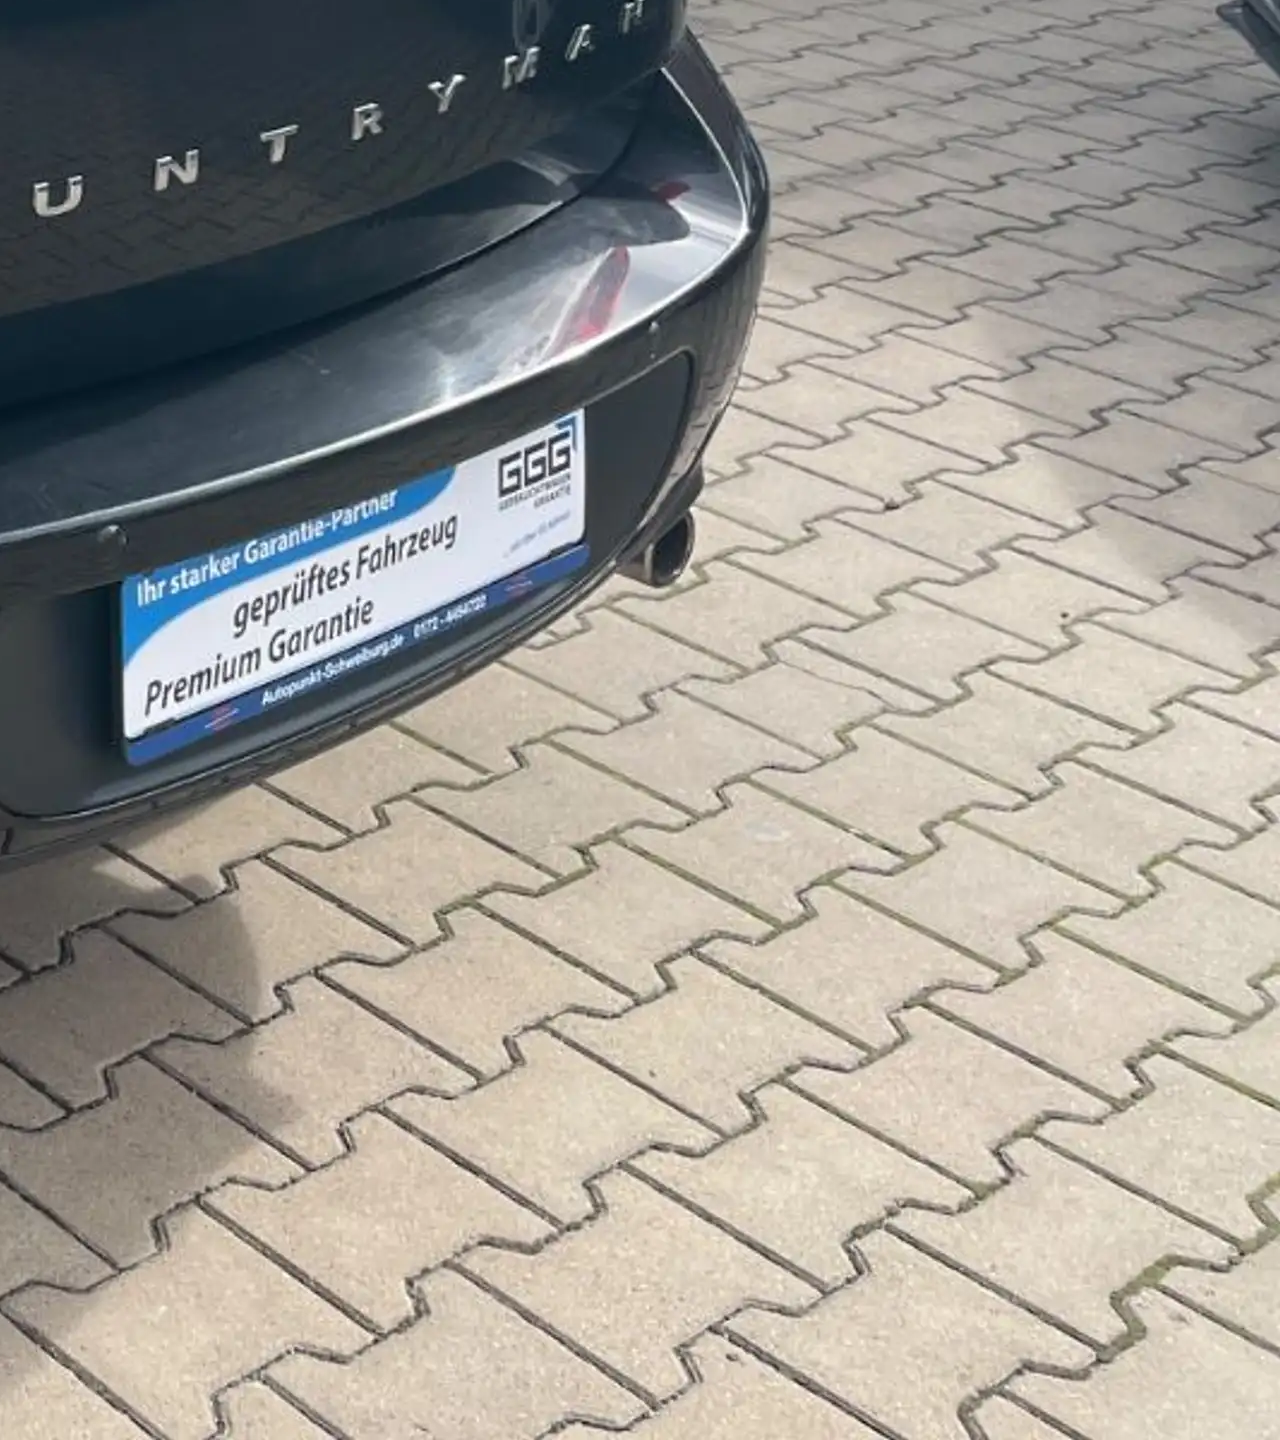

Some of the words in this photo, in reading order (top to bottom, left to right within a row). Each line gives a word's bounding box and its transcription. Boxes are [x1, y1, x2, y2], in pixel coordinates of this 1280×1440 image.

[498, 430, 571, 499] GGG
[137, 578, 164, 608] Ihr
[169, 551, 240, 595] starker
[244, 489, 398, 565] Garantie-Partner
[232, 556, 351, 638] geprüftes
[354, 514, 459, 580] Fahrzeug
[144, 645, 262, 716] Premium
[268, 597, 375, 664] Garantie
